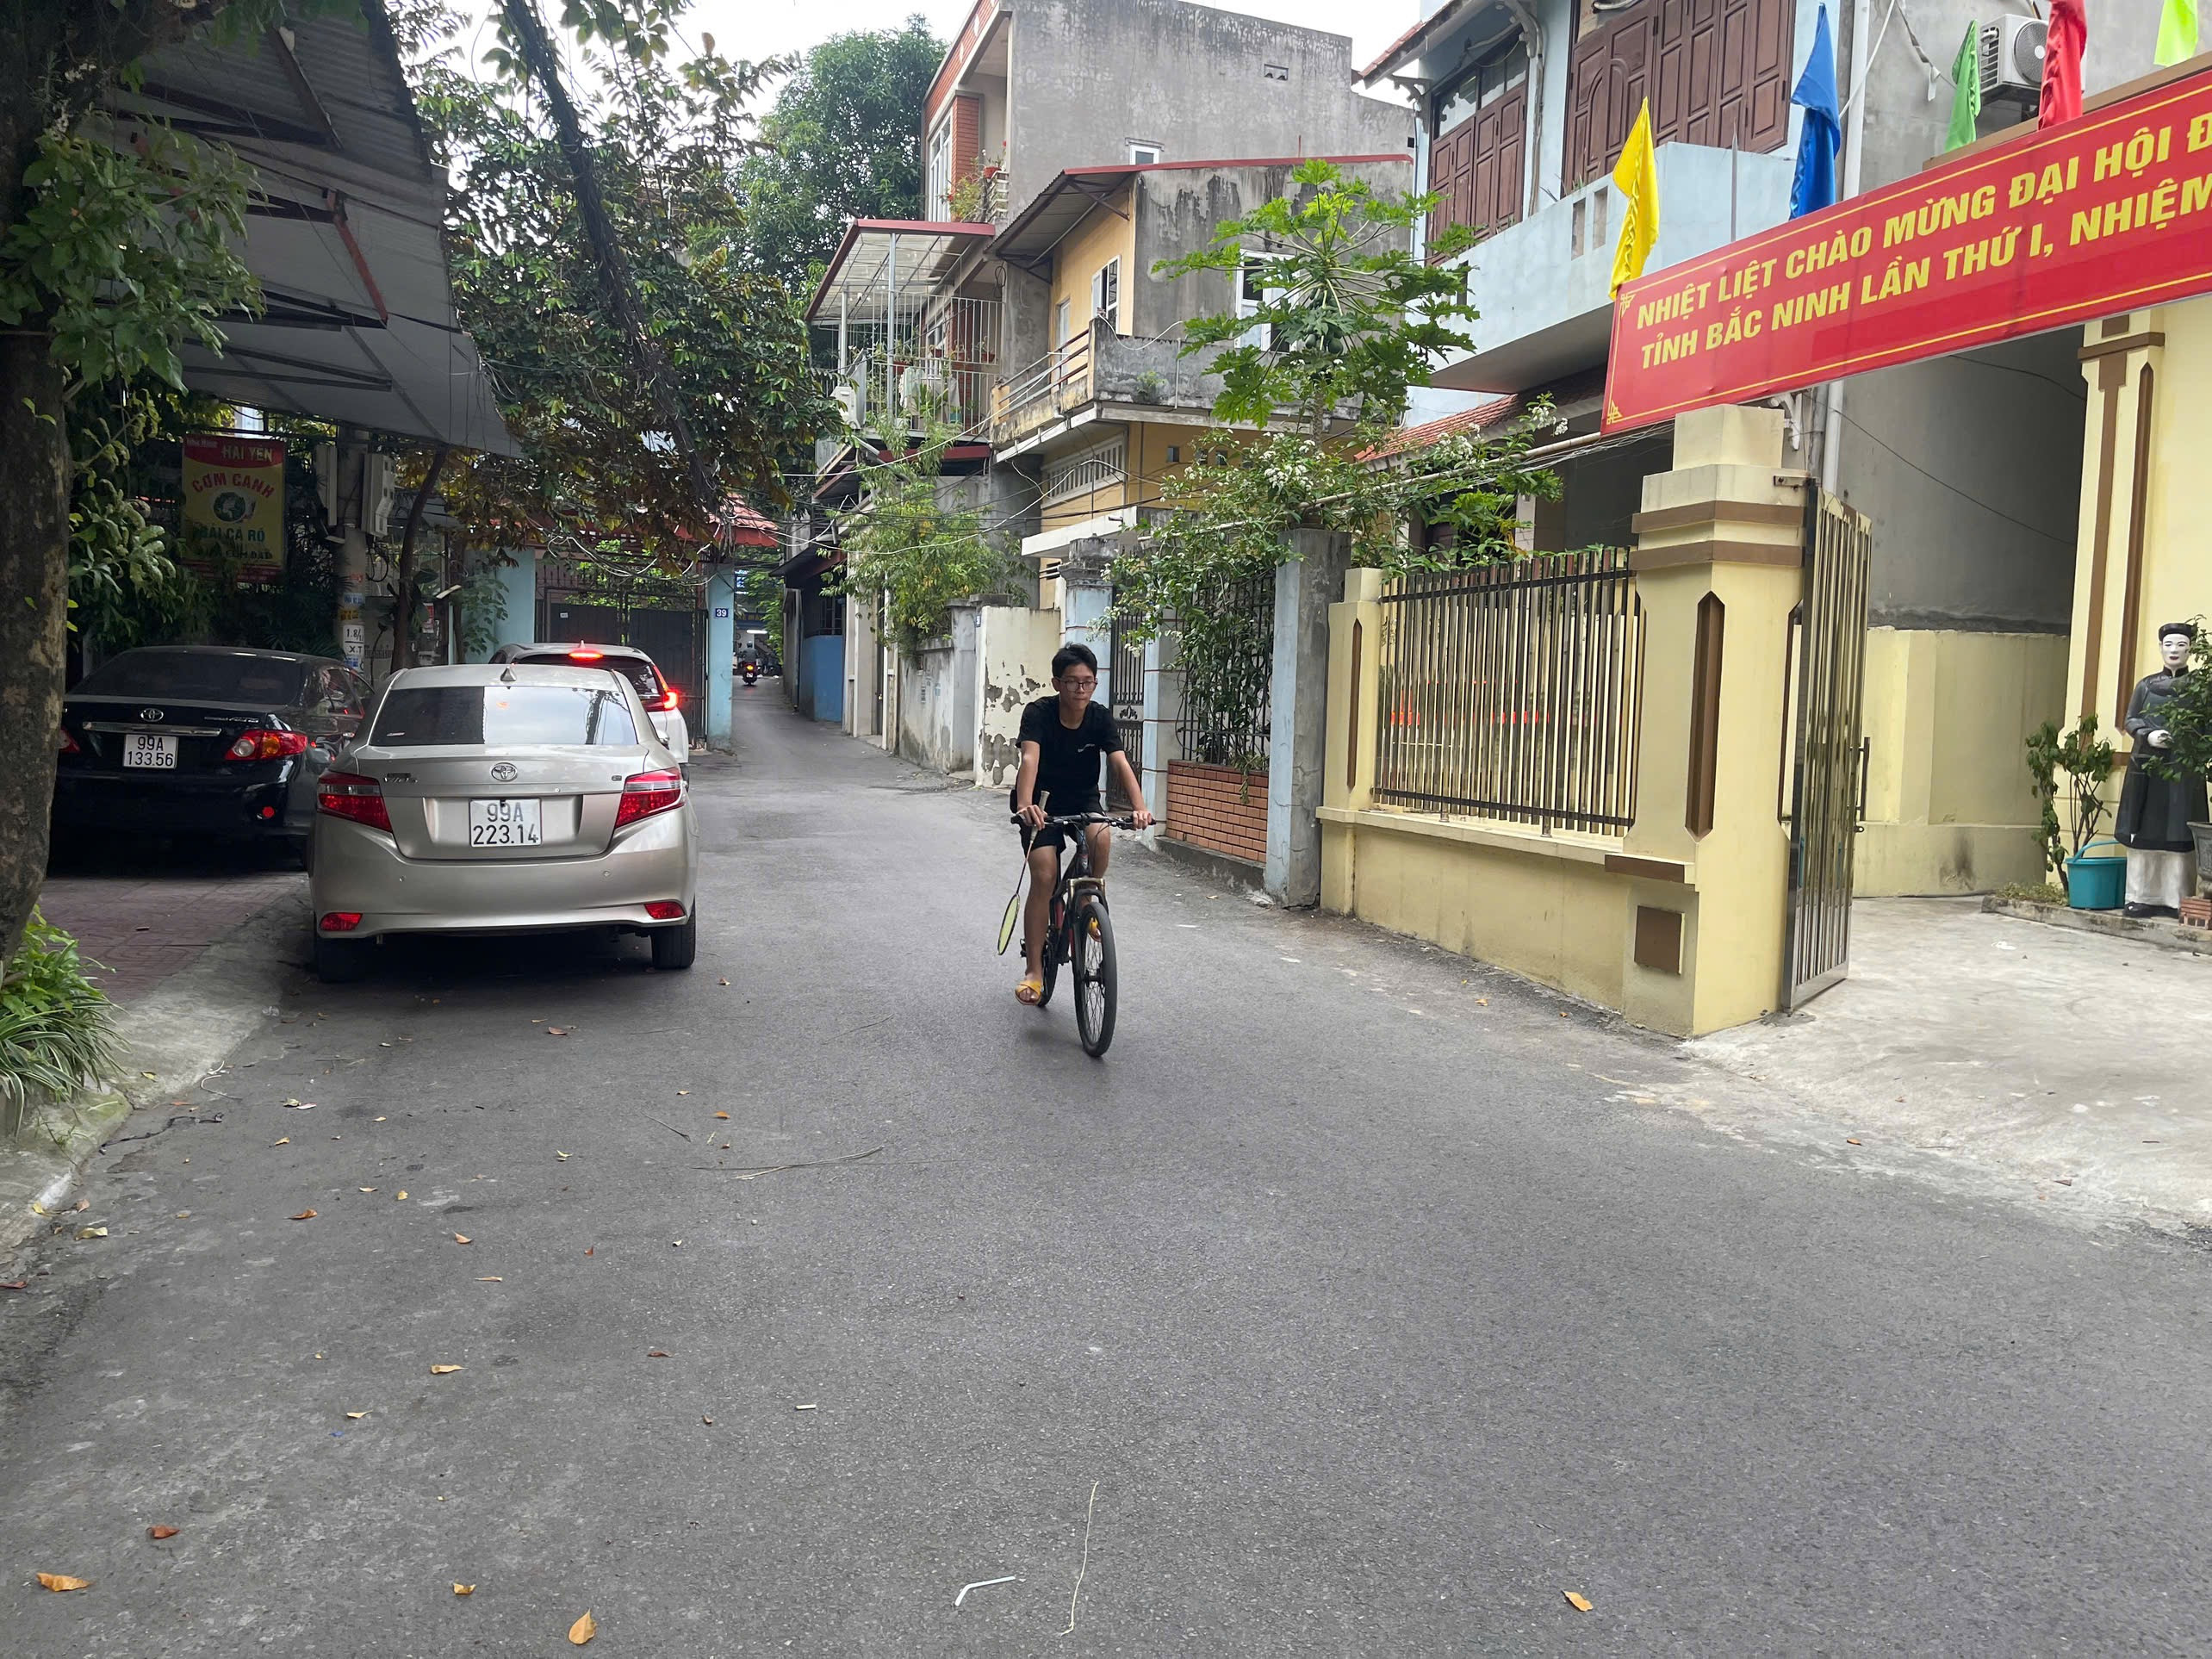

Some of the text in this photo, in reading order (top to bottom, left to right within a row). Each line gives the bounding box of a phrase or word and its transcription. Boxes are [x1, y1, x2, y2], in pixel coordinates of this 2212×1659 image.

[1637, 282, 1712, 330] NHIỆT
[1718, 258, 1777, 302] LIỆT
[1785, 227, 1872, 280] CHÀO
[1883, 184, 1996, 249] MỪNG
[2008, 156, 2079, 208] ĐẠI
[2093, 126, 2172, 183] HỘI
[1641, 329, 1699, 370] TỈNH
[1705, 306, 1762, 351] BẮC
[1771, 281, 1851, 332] NINH
[1860, 255, 1931, 307] LẦN
[1942, 226, 2022, 281] THỨ
[232, 473, 275, 499] CANH
[716, 608, 727, 617] 39
[137, 736, 164, 752] 99A
[127, 751, 173, 767] 133.56
[487, 802, 524, 823] 99A
[473, 823, 539, 845] 223.14
